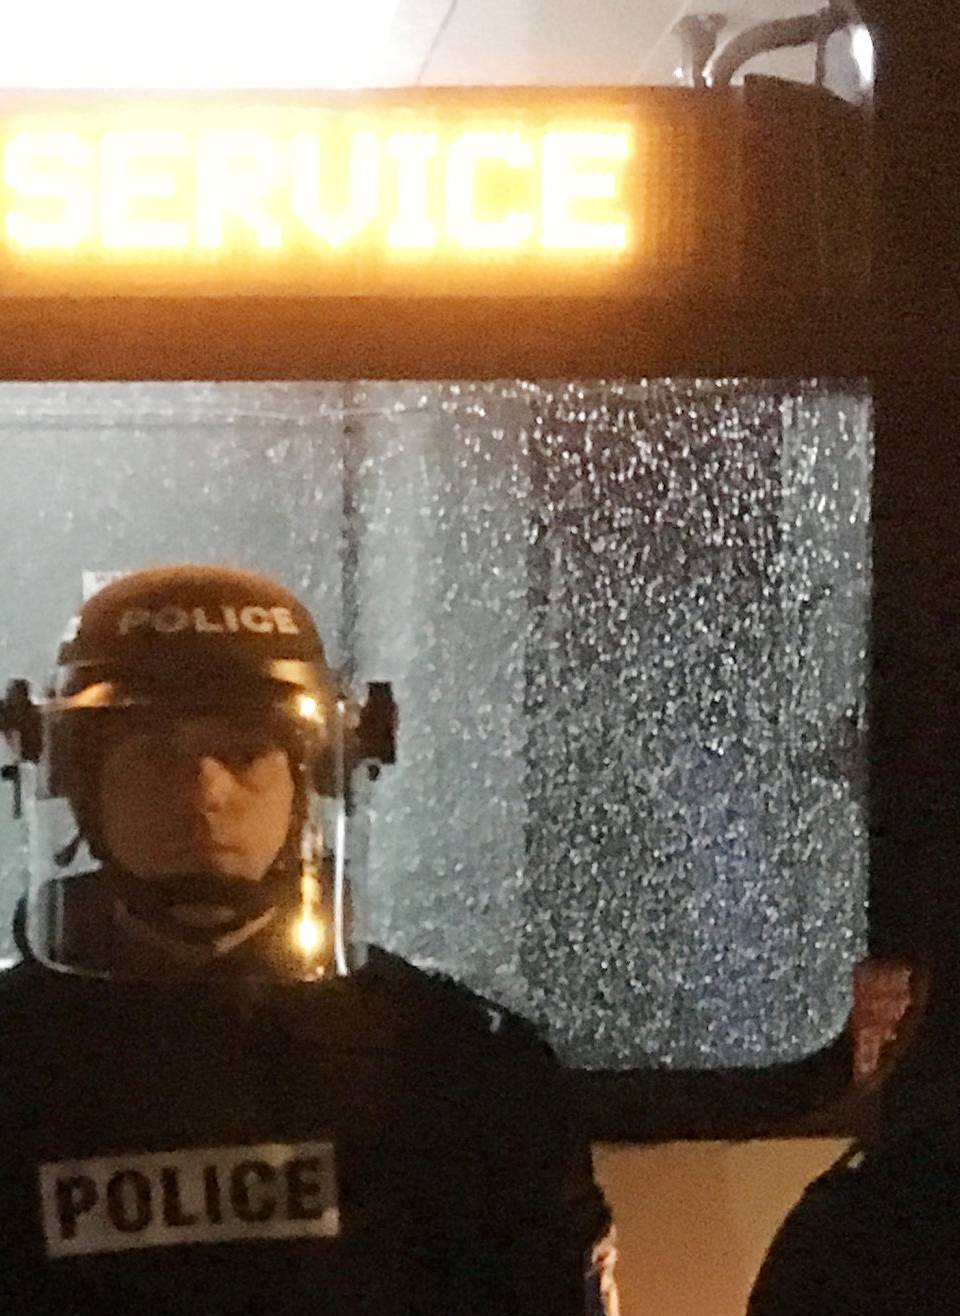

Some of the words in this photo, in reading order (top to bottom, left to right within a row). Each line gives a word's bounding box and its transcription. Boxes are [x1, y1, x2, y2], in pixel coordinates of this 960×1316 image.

[3, 130, 630, 250] SERVICE
[116, 605, 299, 636] POLICE
[55, 1156, 324, 1241] POLICE
